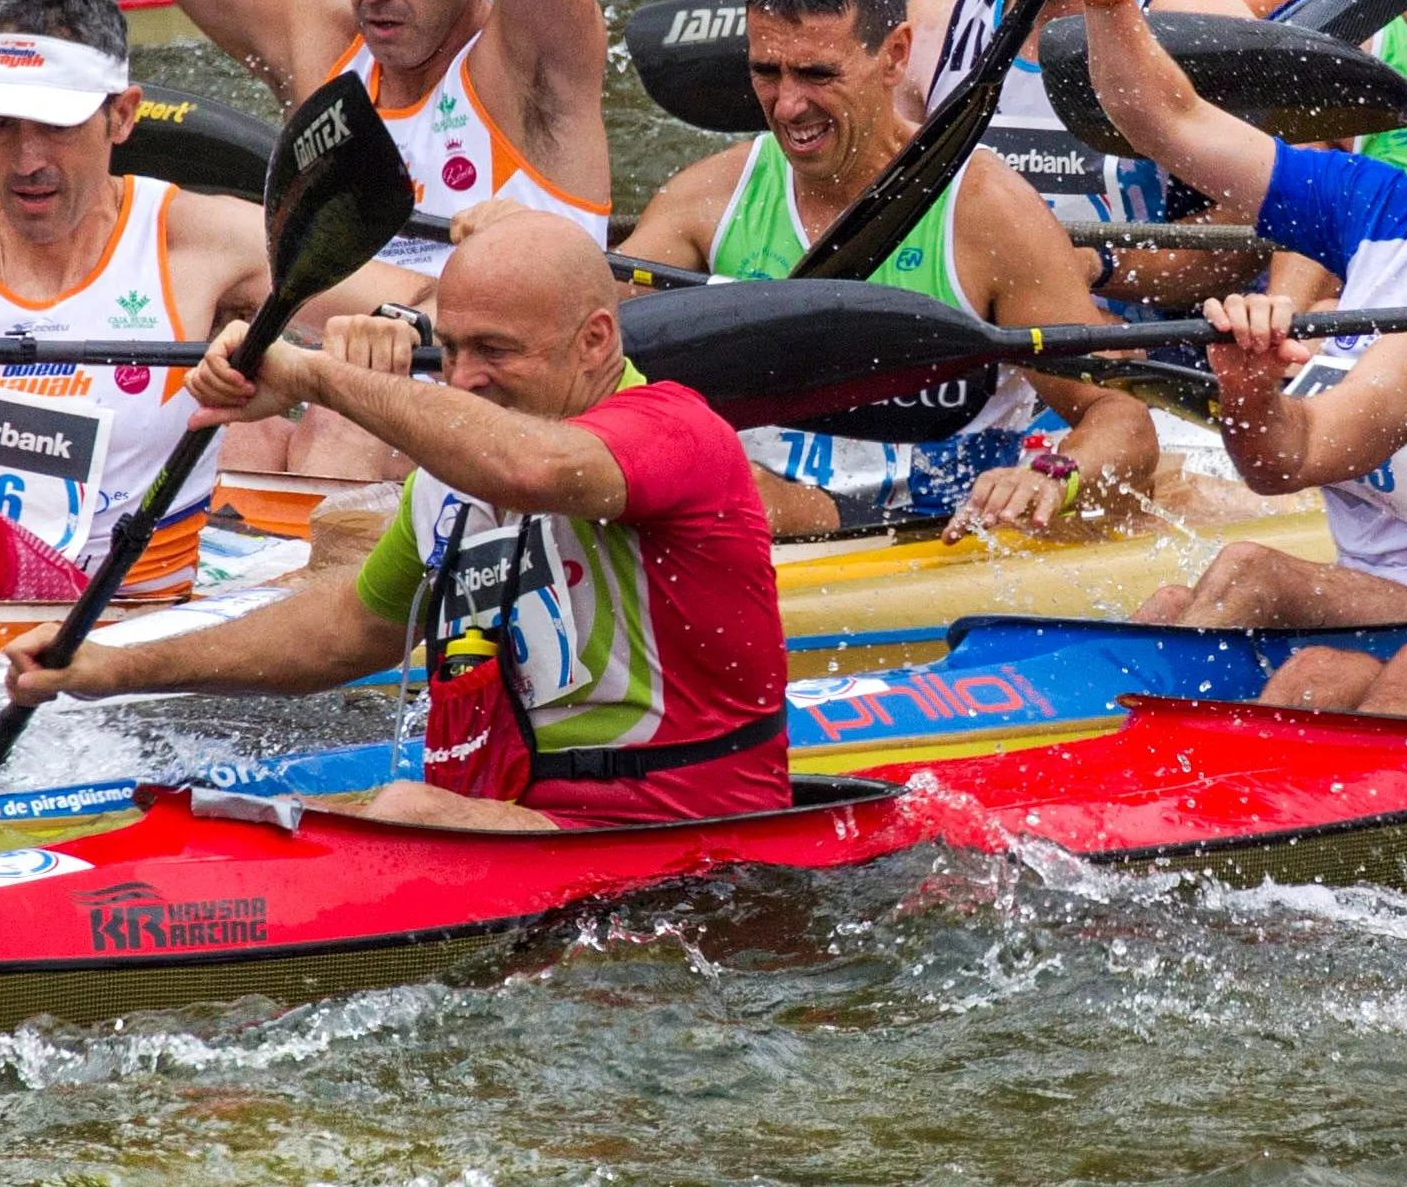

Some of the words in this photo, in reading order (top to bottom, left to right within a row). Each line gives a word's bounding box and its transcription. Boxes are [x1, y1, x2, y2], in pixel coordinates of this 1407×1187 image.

[135, 100, 191, 124] port
[780, 432, 834, 486] 74
[3, 800, 29, 817] de
[32, 785, 133, 818] piragüismo
[90, 904, 168, 951] KR
[170, 919, 268, 946] RACING
